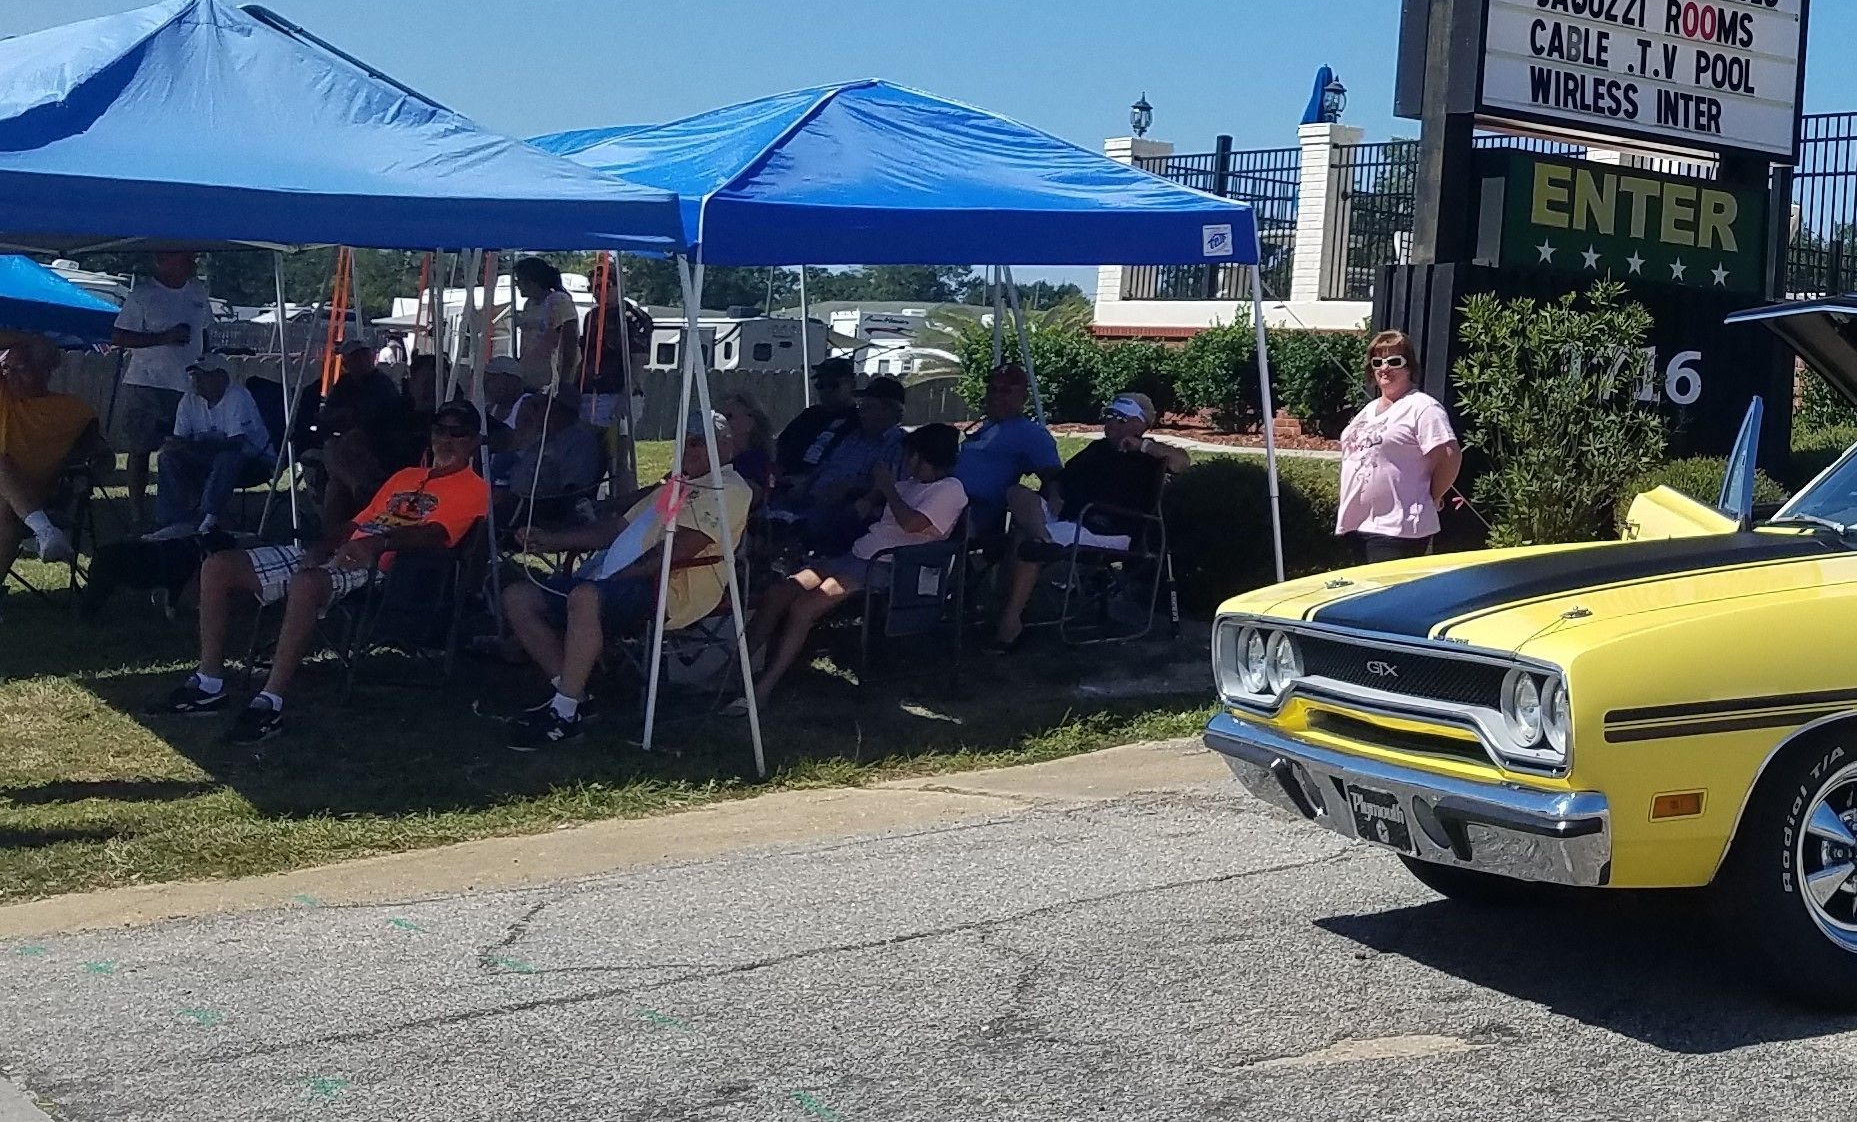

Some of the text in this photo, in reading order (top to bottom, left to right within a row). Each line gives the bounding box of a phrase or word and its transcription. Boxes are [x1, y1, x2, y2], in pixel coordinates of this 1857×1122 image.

[1529, 18, 1610, 68] CABLE
[1694, 49, 1756, 95] POOL
[1529, 65, 1722, 134] WIRLESS INTER
[1530, 161, 1739, 253] ENTER
[1366, 660, 1399, 678] GTX
[1349, 791, 1405, 825] Plymouth
[1781, 745, 1846, 893] Radial T/A
